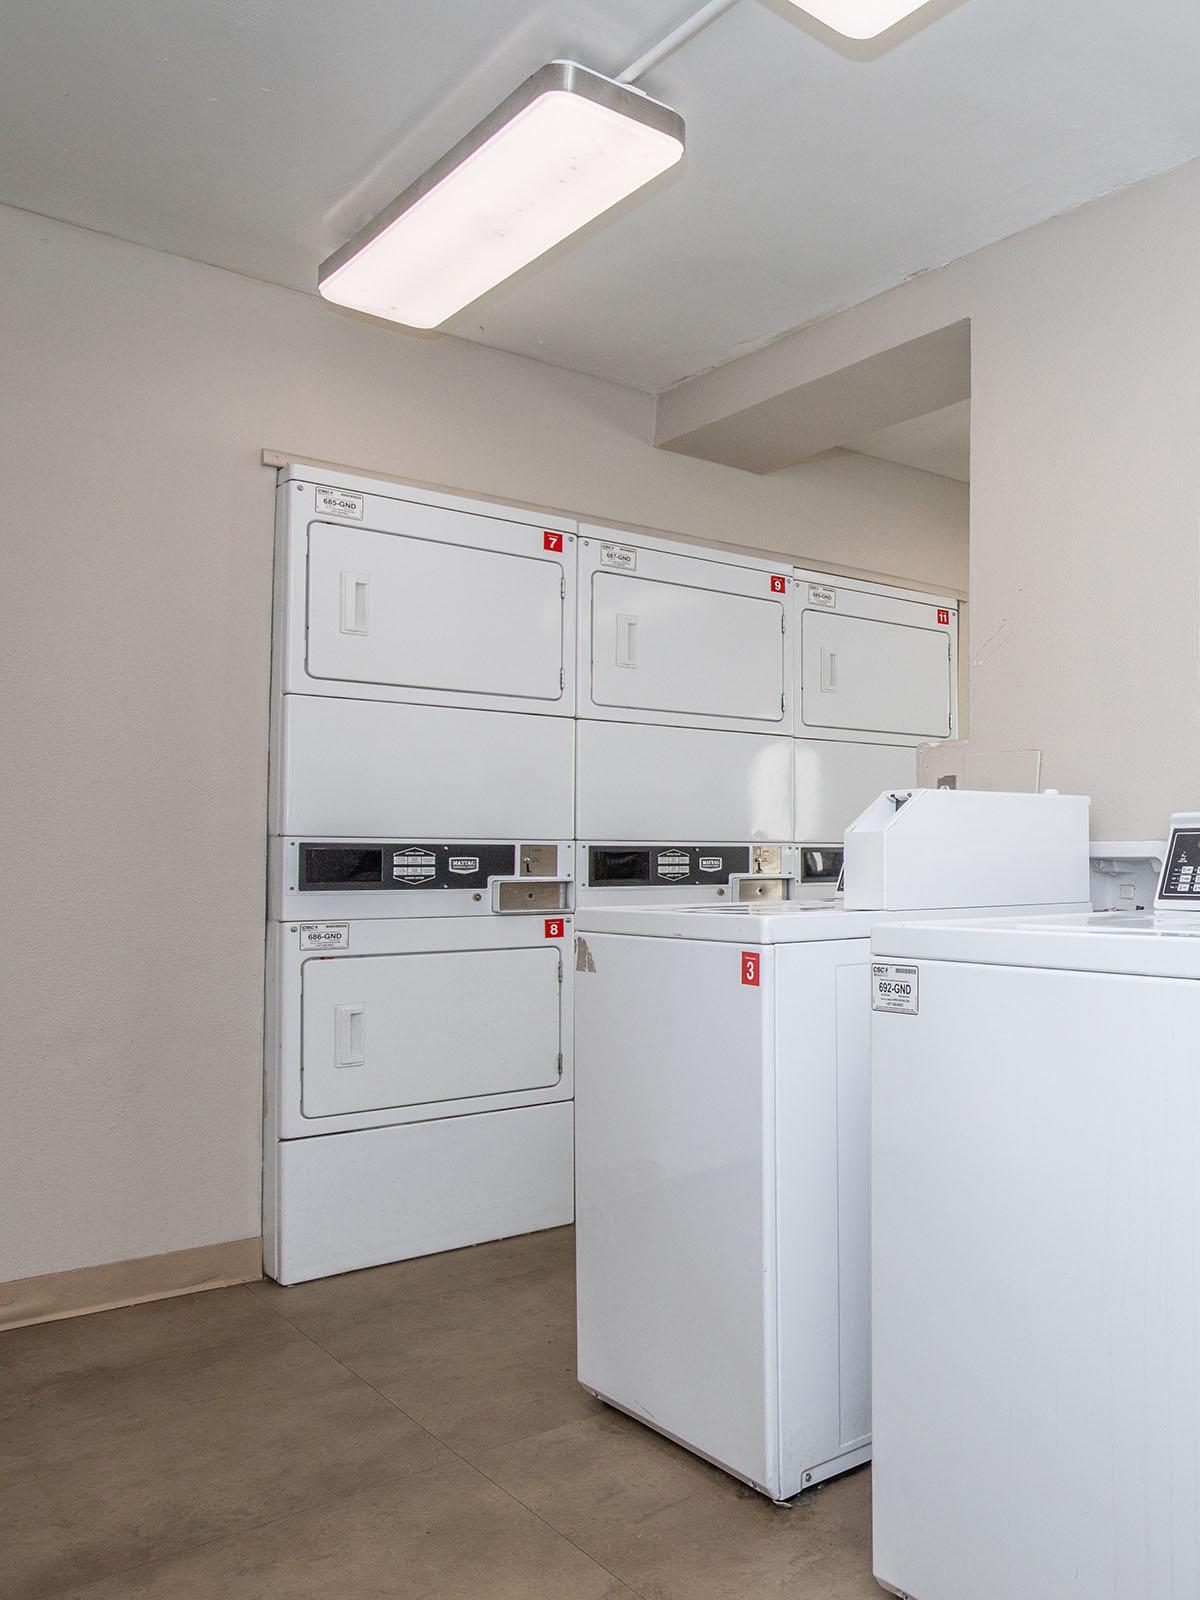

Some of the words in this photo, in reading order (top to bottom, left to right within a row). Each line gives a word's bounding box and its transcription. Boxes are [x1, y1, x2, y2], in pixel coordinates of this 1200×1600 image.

[323, 498, 357, 510] 685-GND
[548, 537, 558, 549] 7
[774, 580, 782, 591] 9
[938, 613, 947, 623] 11
[550, 923, 559, 936] 8
[308, 932, 342, 941] 686-GND
[746, 960, 755, 980] 3
[879, 982, 912, 995] 692-GND
